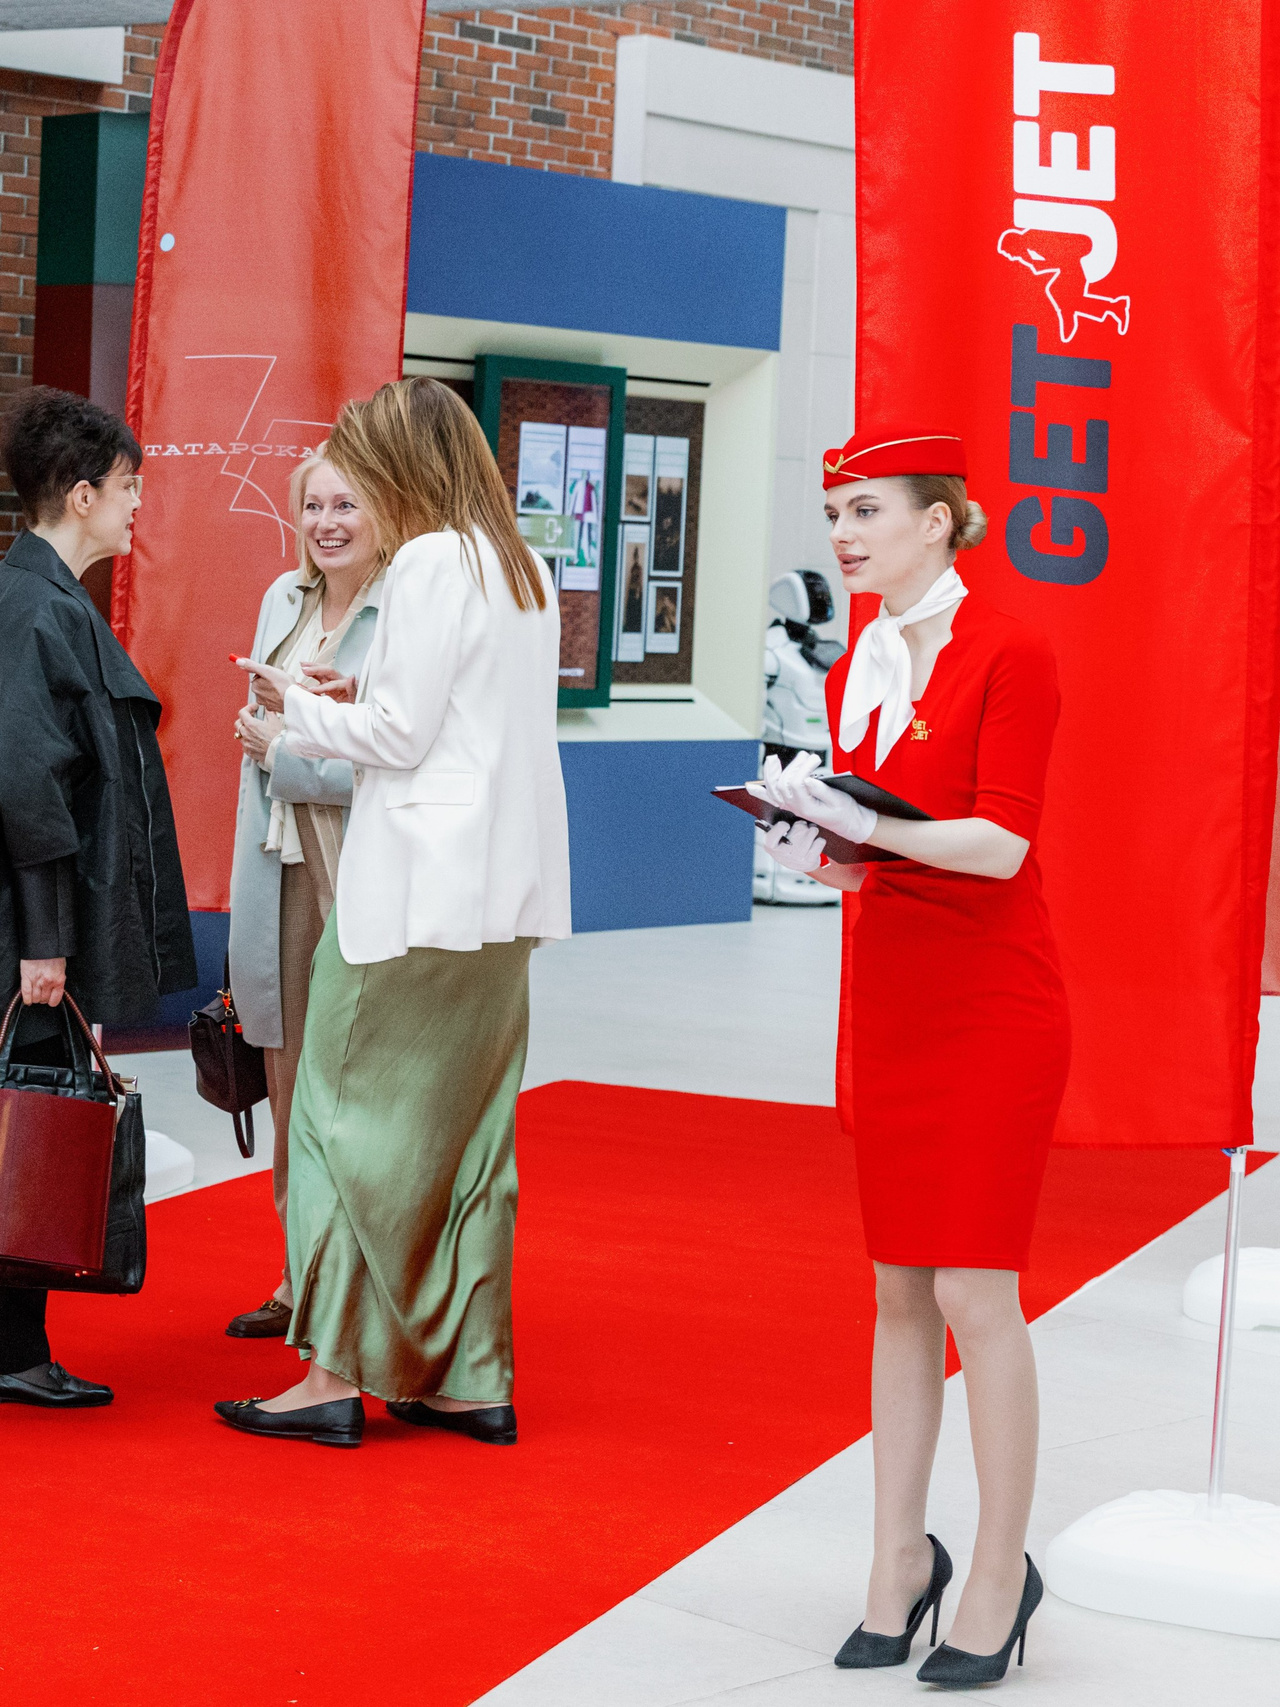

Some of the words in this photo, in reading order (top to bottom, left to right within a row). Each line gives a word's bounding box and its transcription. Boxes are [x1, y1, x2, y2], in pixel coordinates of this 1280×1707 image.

[1013, 31, 1118, 284] JET
[145, 442, 317, 458] ТАТАРСКА
[1005, 323, 1112, 586] GET
[912, 718, 926, 730] GET
